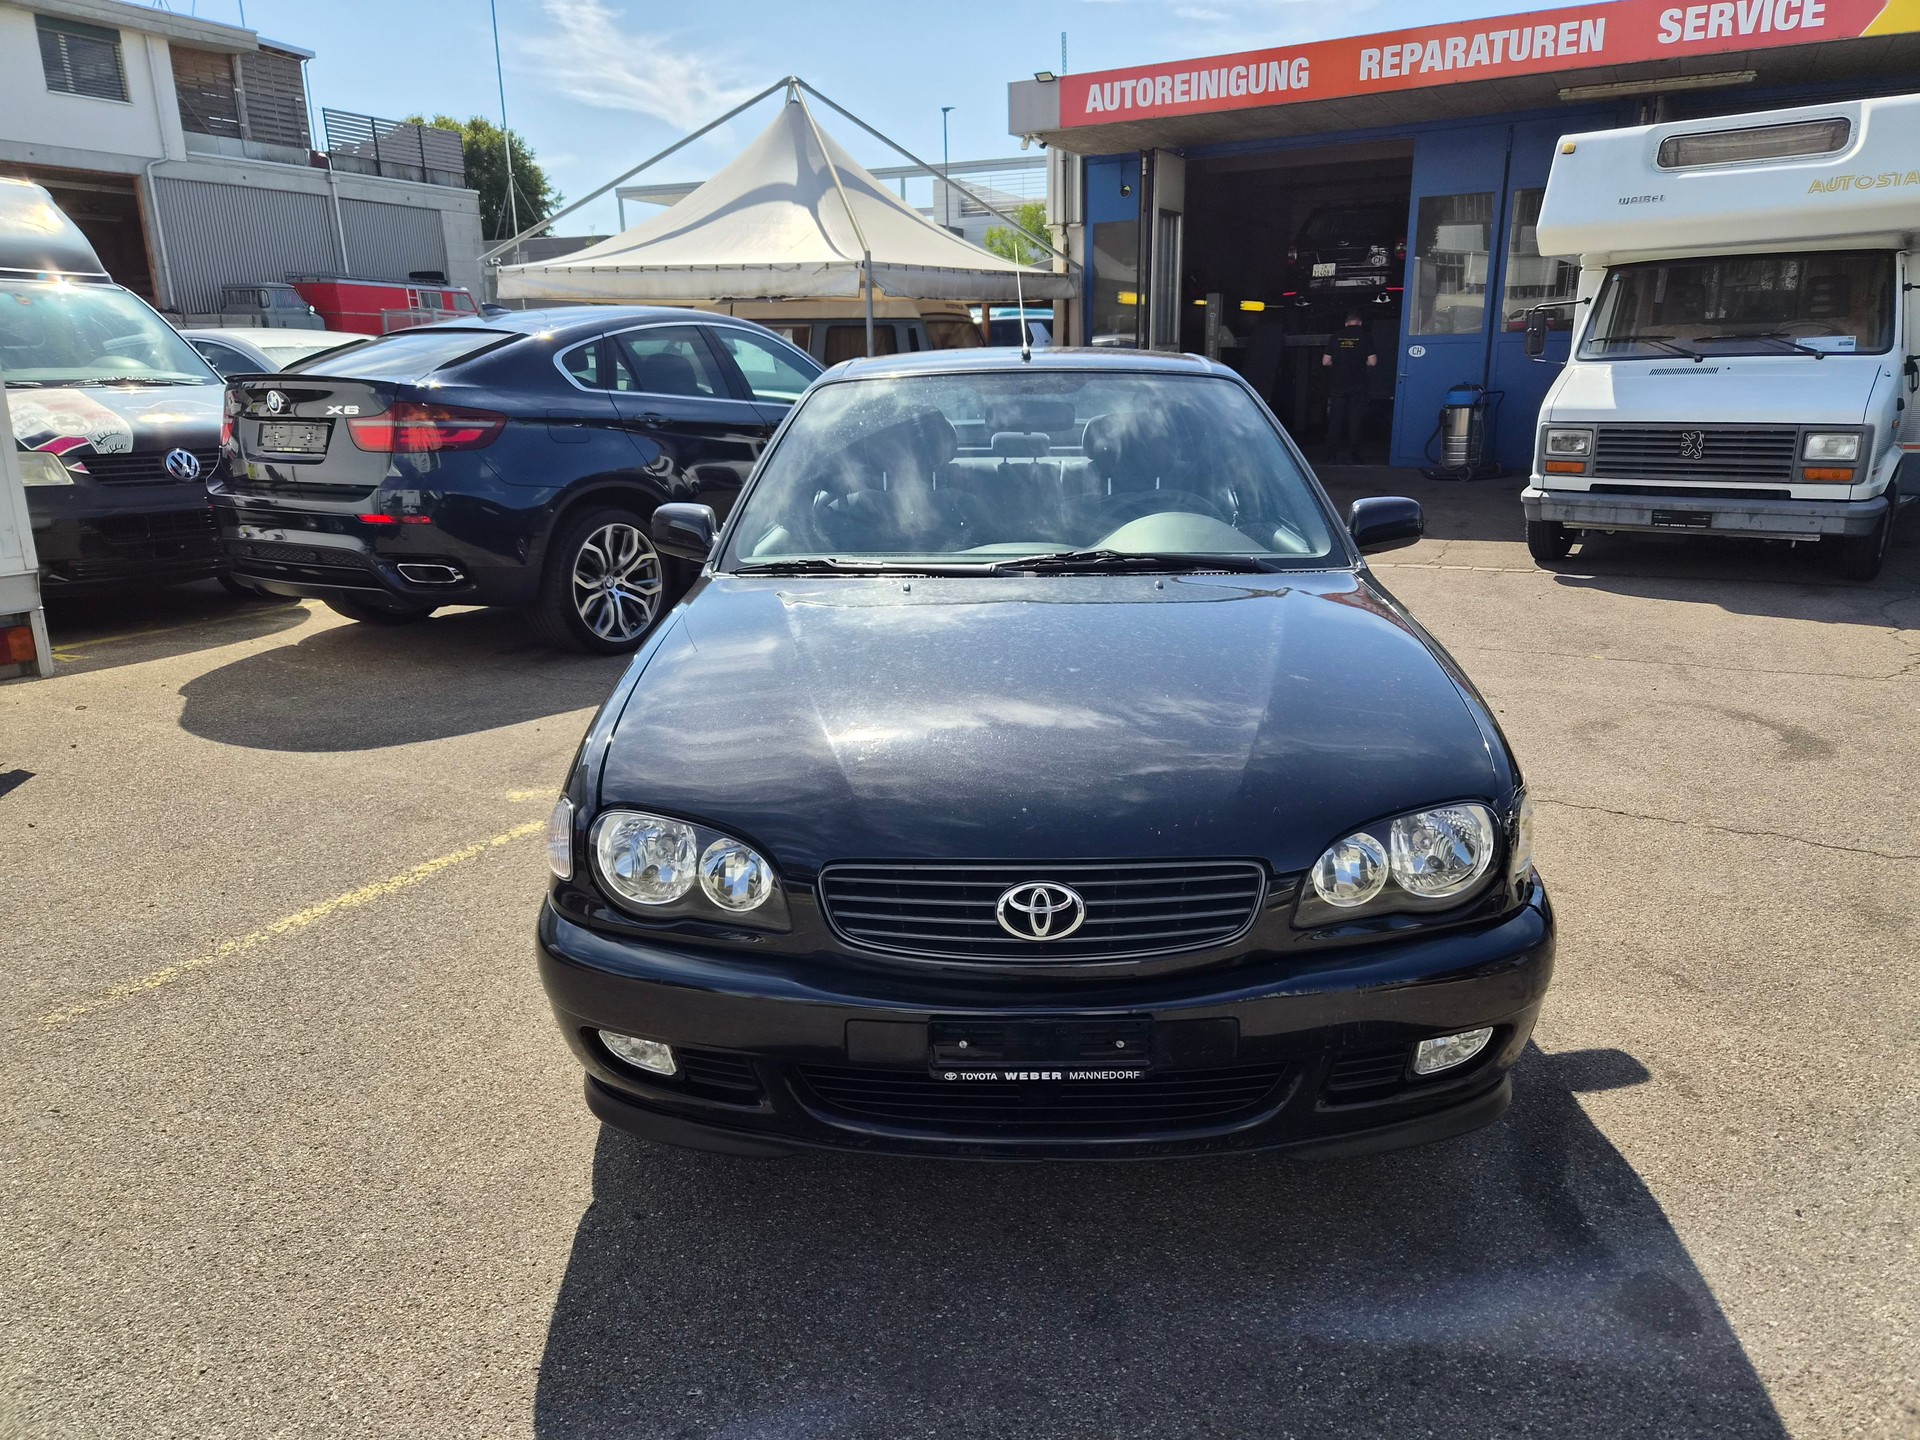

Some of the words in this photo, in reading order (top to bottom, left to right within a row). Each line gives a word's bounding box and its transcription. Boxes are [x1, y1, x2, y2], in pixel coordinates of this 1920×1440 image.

[1085, 57, 1310, 113] AUTOREINIGUNG
[1359, 18, 1606, 81] REPARATUREN
[1657, 0, 1826, 44] SERVICE
[1412, 346, 1422, 355] CH
[325, 405, 360, 415] X6
[960, 1072, 998, 1081] TOYOTA
[1004, 1071, 1062, 1081] WEBER
